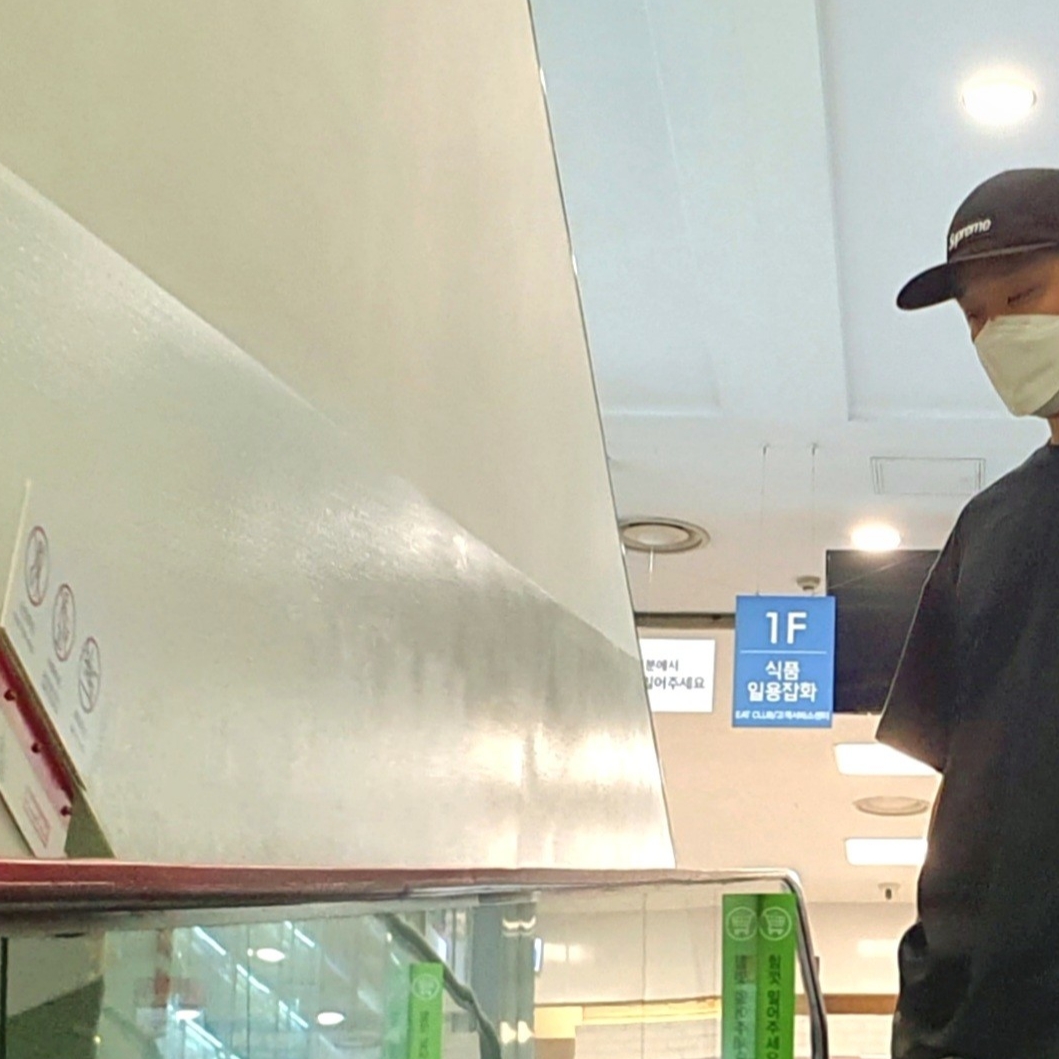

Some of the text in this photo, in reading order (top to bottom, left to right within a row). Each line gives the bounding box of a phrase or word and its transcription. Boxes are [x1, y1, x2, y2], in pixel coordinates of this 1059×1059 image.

[765, 611, 808, 645] 1F
[765, 660, 800, 681] 식품
[747, 681, 818, 703] 일용잡화
